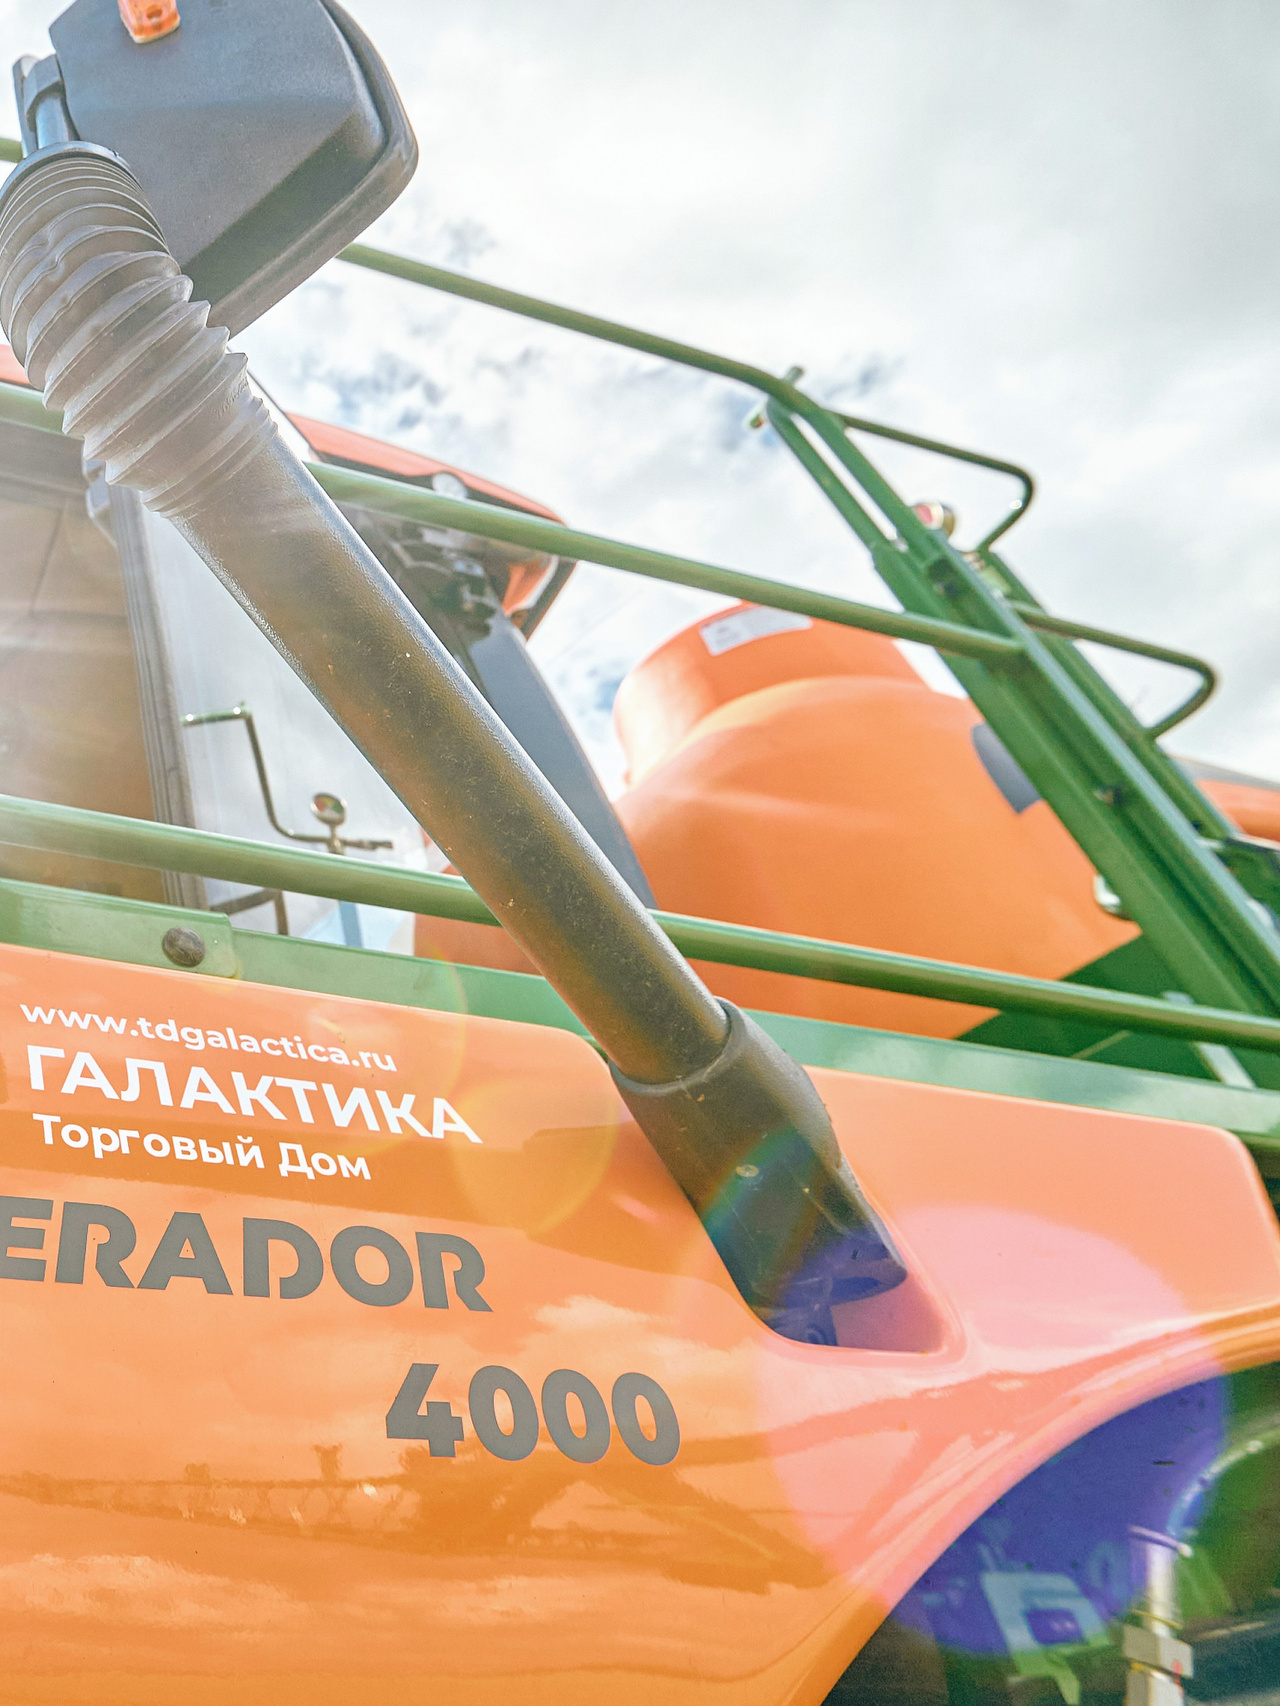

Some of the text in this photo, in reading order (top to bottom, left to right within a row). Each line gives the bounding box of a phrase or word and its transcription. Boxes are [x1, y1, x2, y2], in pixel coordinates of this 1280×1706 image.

[21, 1004, 397, 1072] www.tdgalactica.ru
[27, 1046, 484, 1144] ГАЛАКТИКА
[33, 1114, 372, 1180] Торговый Дом
[385, 1362, 680, 1466] 4000
